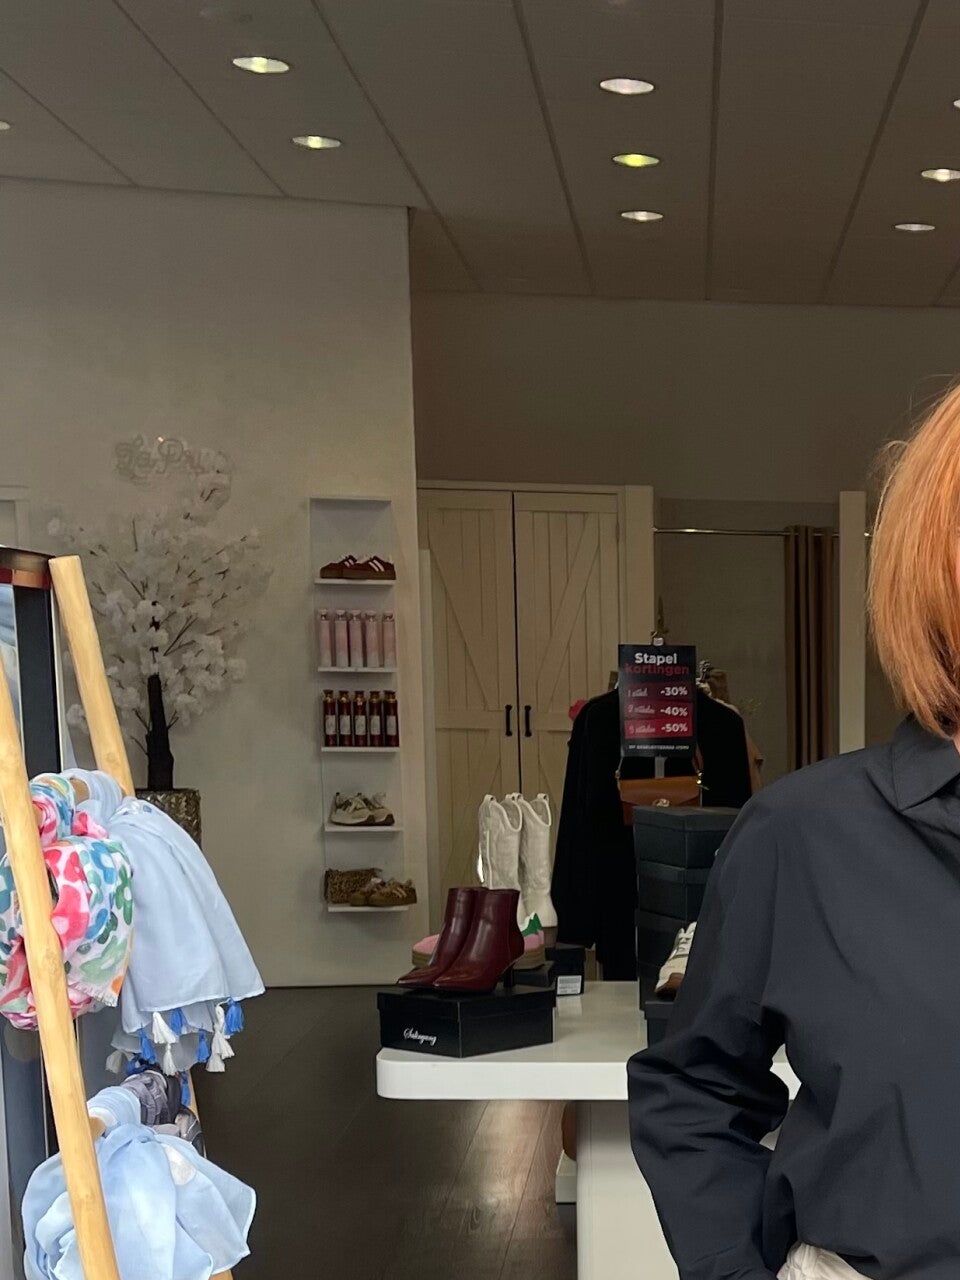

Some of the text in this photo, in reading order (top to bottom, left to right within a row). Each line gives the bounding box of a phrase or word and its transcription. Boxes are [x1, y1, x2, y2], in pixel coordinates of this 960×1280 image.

[634, 652, 678, 665] Stapel
[624, 663, 689, 676] kortingen
[660, 686, 688, 696] -30%
[660, 706, 688, 717] -40%
[660, 723, 688, 733] -50%
